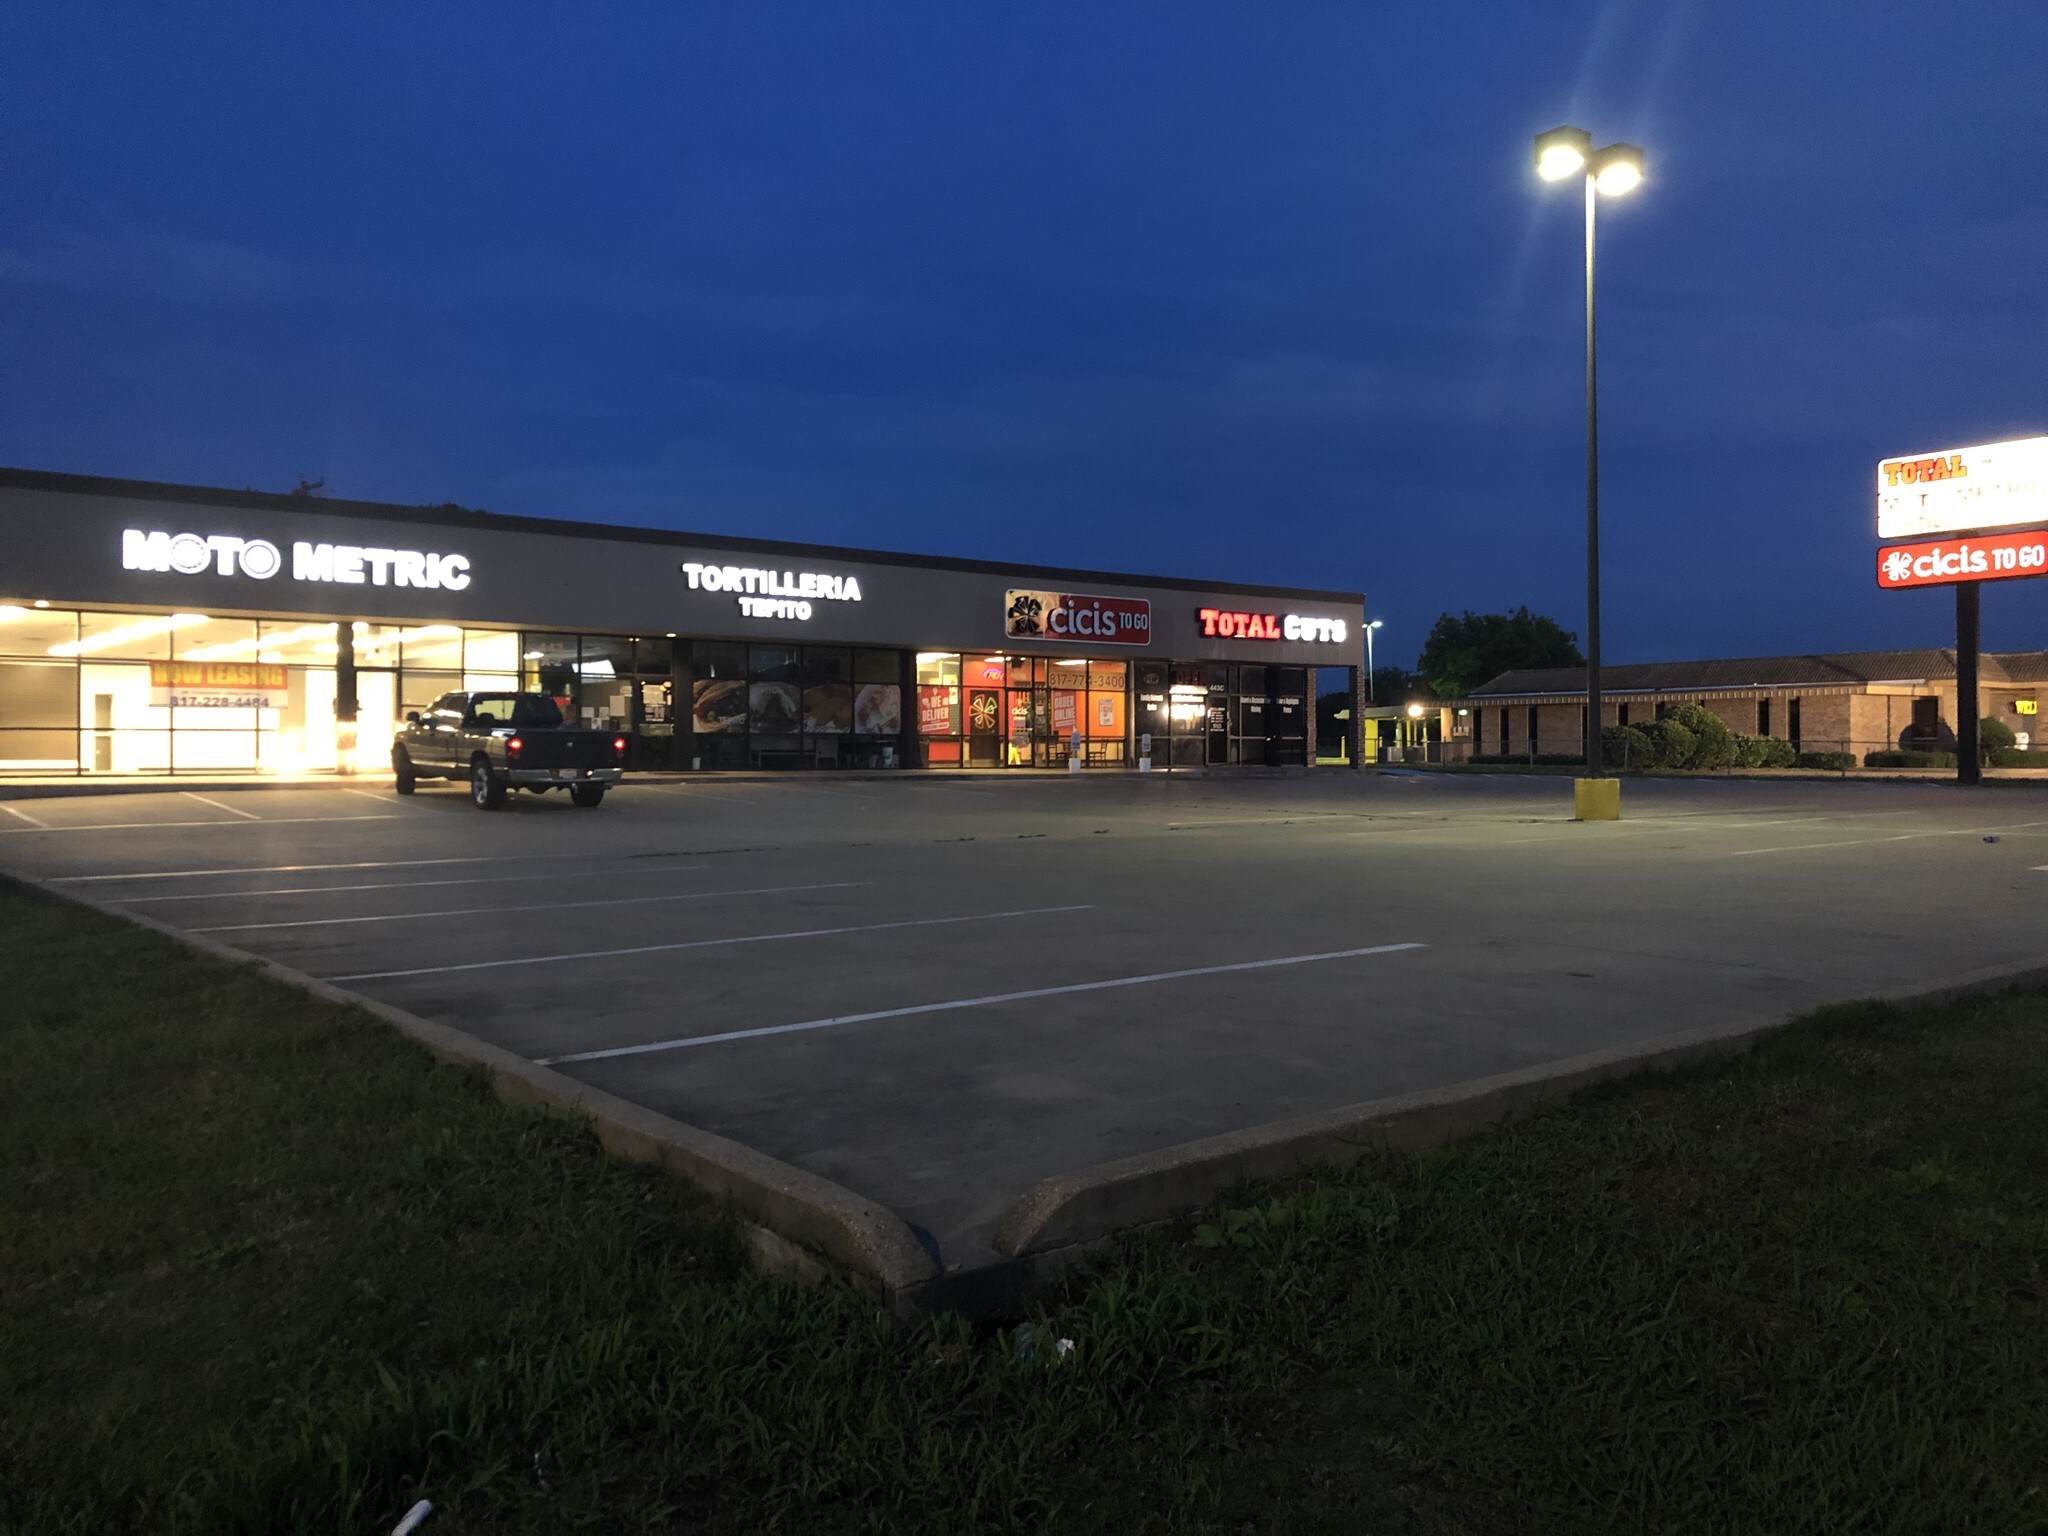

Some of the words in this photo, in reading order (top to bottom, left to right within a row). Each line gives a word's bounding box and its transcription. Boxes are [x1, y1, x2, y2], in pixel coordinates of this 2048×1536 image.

[1883, 455, 1967, 487] TOTAL
[122, 529, 281, 579] MOTO
[293, 541, 471, 590] METRIC
[1913, 545, 1988, 578] cicis
[1992, 548, 2016, 571] TO
[2018, 545, 2045, 568] GO
[682, 563, 862, 601] TORTILLERIA
[738, 597, 812, 620] TEPITO
[1050, 600, 1116, 636] cicis
[1119, 612, 1132, 629] TO
[1133, 614, 1148, 630] GO
[1200, 608, 1281, 639] TOTAL
[1283, 614, 1347, 643] CUTS
[154, 663, 202, 684] NOW
[206, 665, 284, 686] LEASING
[1049, 673, 1125, 688] 817-774-3400
[922, 707, 949, 721] DELIVER
[930, 695, 942, 708] WE
